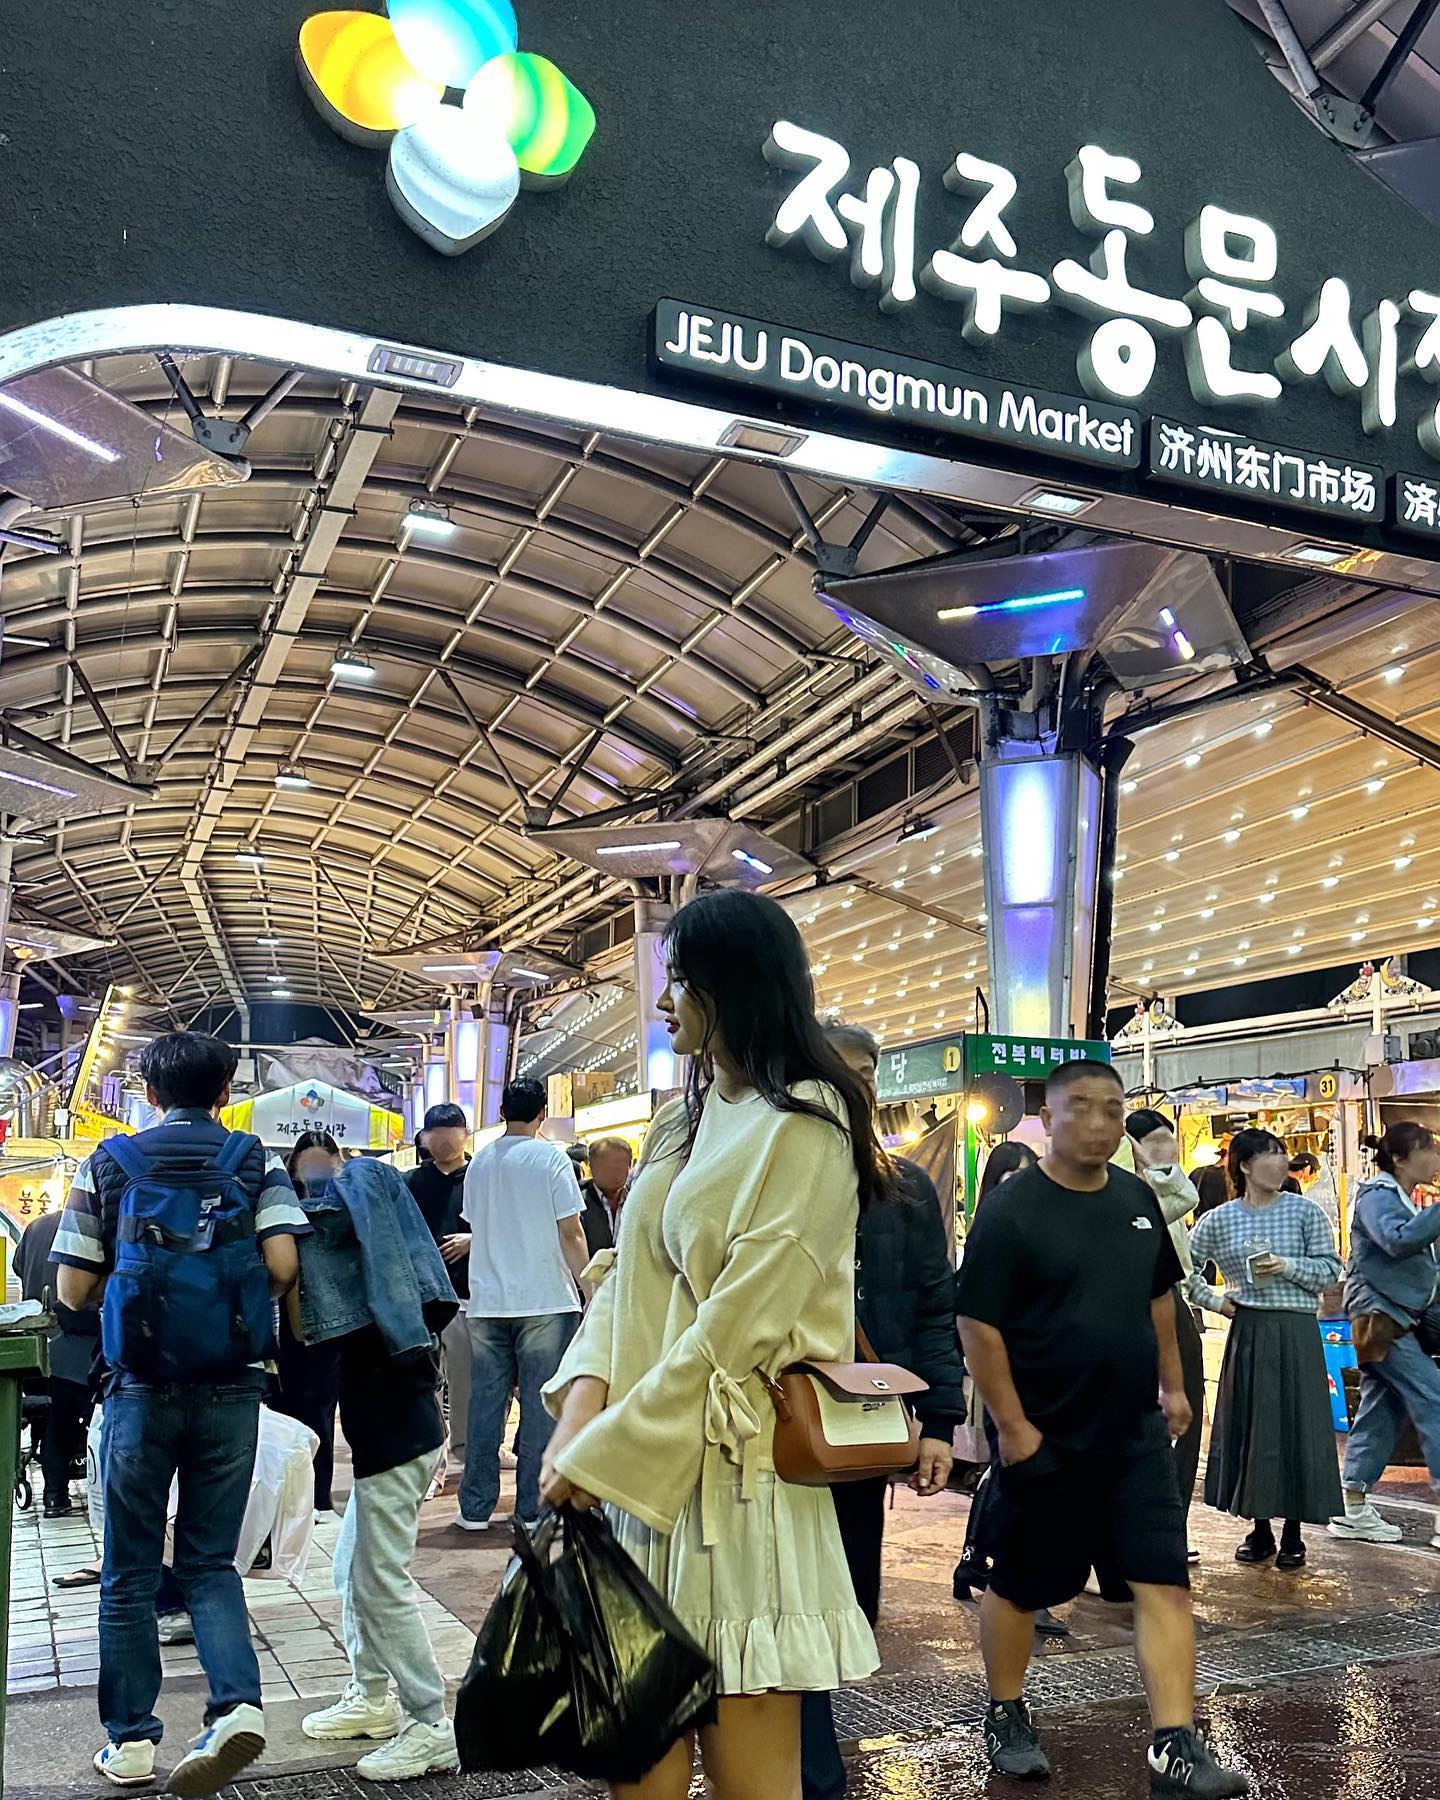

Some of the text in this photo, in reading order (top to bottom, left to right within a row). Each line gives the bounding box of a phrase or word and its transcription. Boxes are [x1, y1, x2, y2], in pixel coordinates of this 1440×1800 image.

[664, 311, 1135, 456] JEJU Dongmun Market
[1159, 423, 1377, 513] 济州东门市场
[1321, 1079, 1334, 1093] 31
